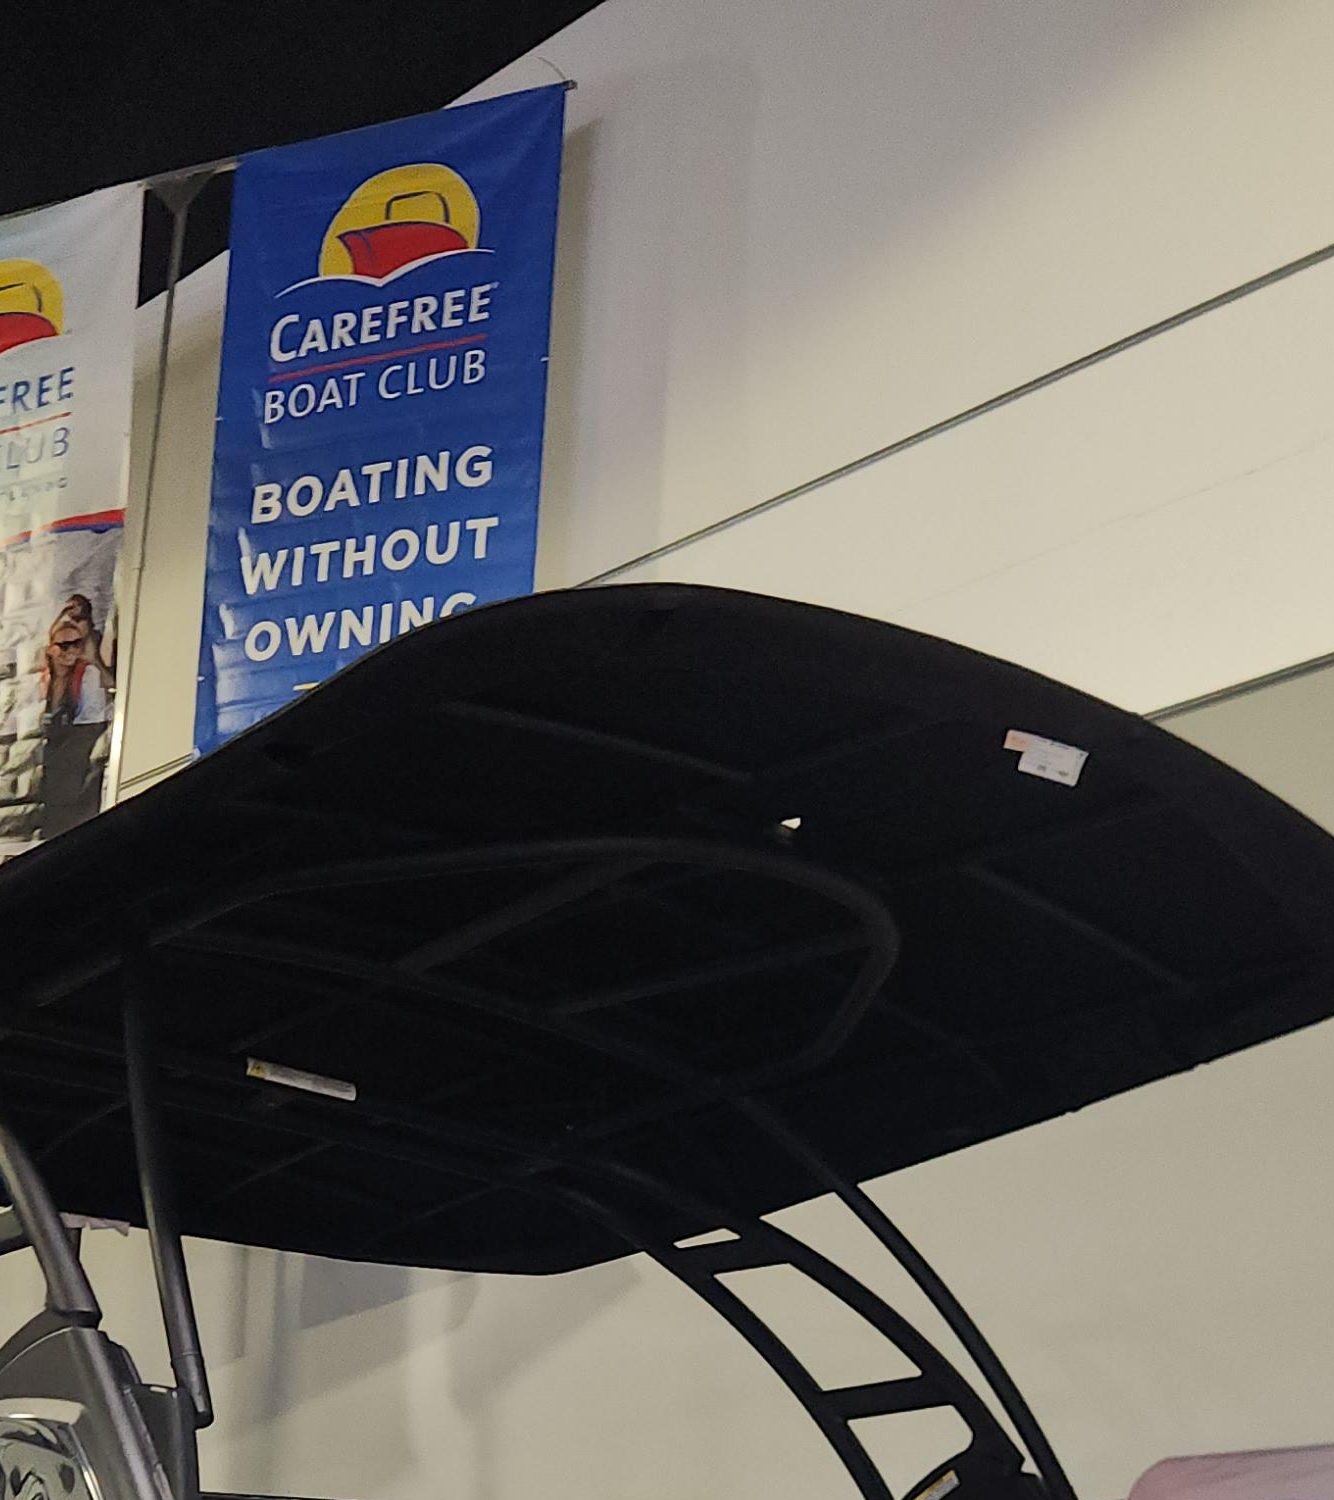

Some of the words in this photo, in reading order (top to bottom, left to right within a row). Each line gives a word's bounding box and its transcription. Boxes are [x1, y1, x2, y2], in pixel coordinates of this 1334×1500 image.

[270, 284, 492, 362] CAREFREE
[264, 372, 365, 424] BOAT
[378, 349, 487, 399] CLUB
[251, 445, 493, 524] BOATING
[239, 517, 499, 595] WITHOUT
